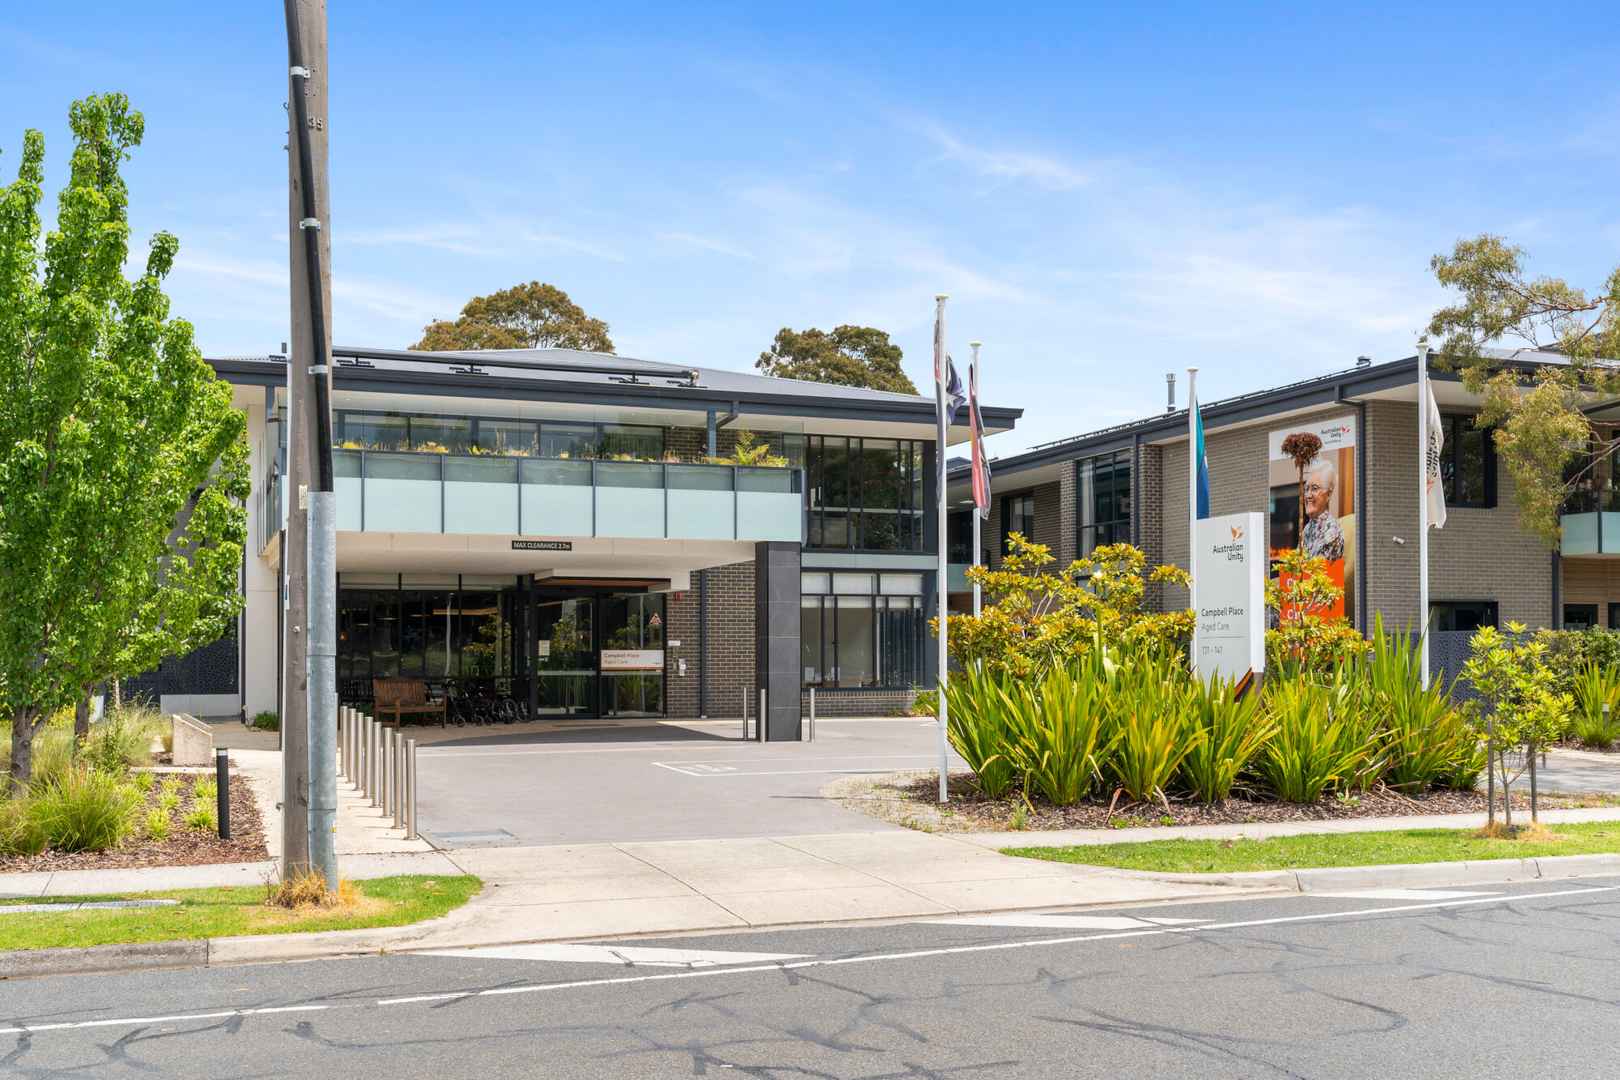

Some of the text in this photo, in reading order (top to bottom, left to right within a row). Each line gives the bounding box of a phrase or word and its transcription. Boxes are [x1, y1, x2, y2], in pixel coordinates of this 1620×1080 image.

[1213, 543, 1244, 554] Australian
[1228, 552, 1244, 562] Unity
[1201, 607, 1244, 618] Campbell Place
[1201, 621, 1230, 632] Aged Care
